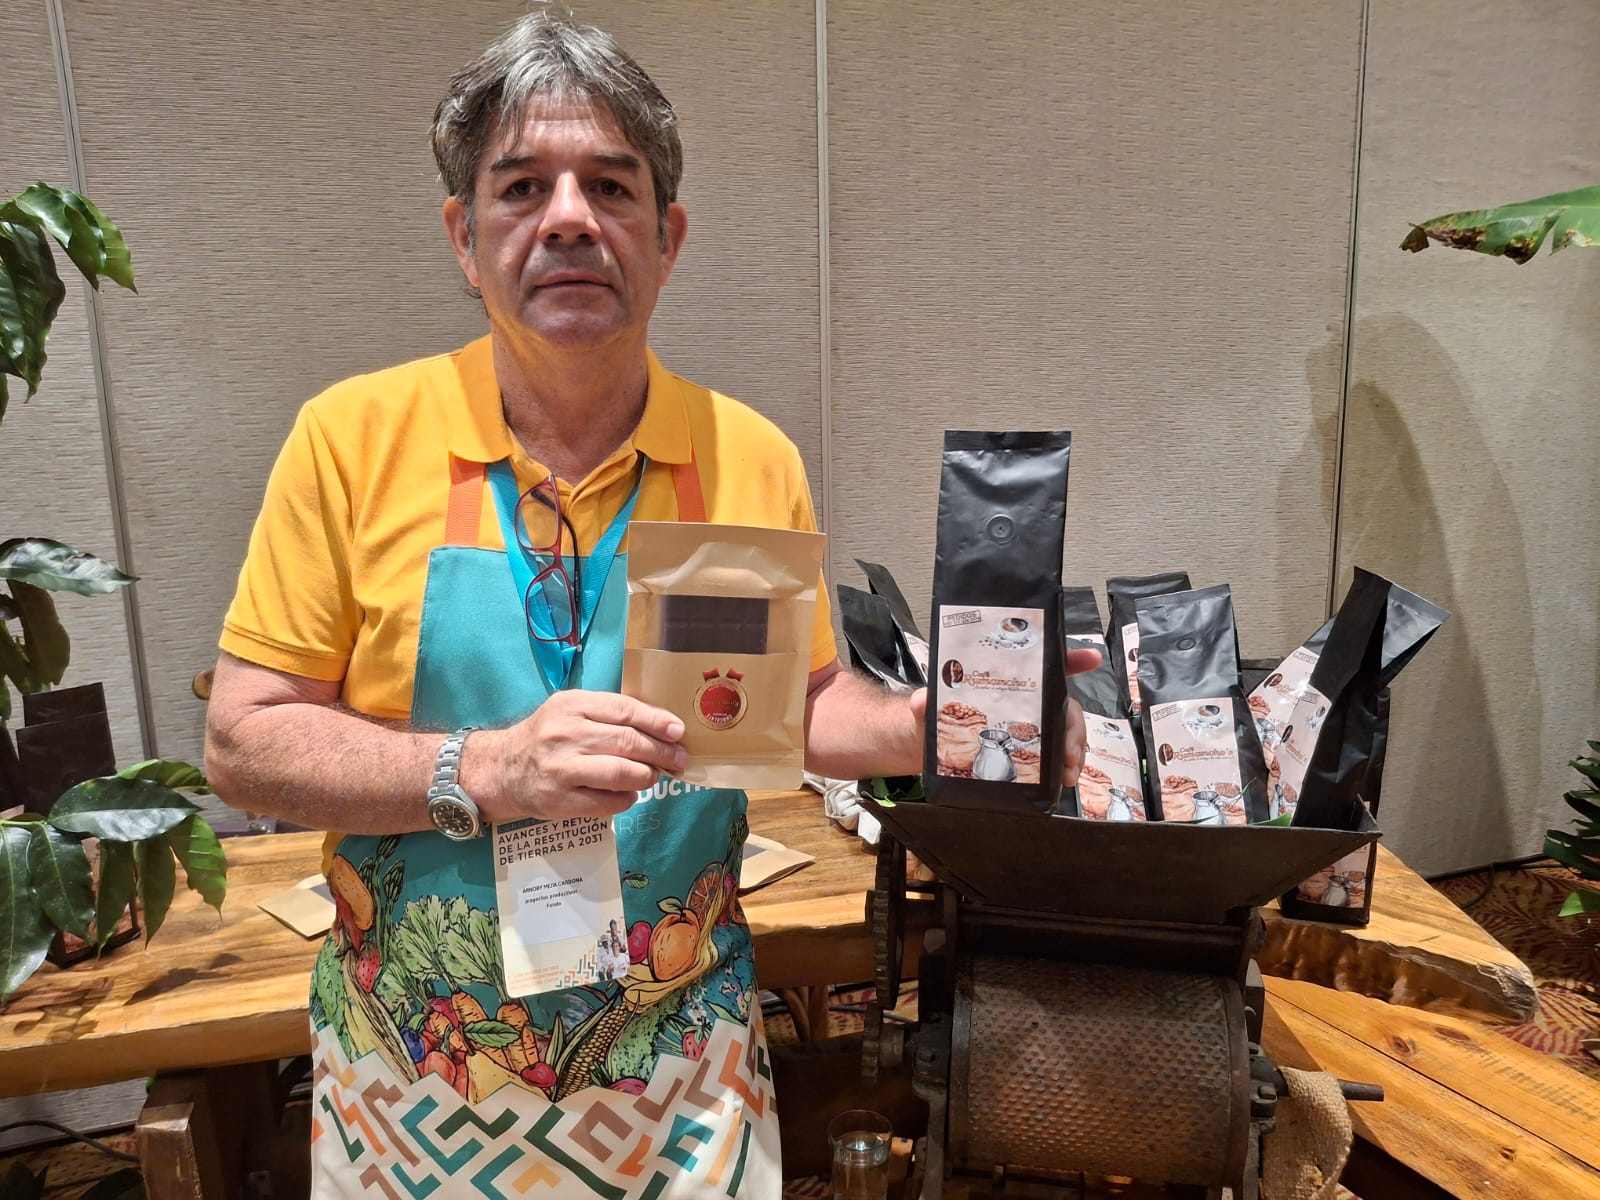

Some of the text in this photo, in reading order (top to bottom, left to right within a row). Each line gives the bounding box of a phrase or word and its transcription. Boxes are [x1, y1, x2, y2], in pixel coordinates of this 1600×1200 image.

[498, 825, 549, 845] AVANCES
[552, 823, 559, 831] Y
[499, 821, 608, 855] DE LA RESTITUCIÓN
[500, 833, 603, 865] DE TIERRAS A 2031
